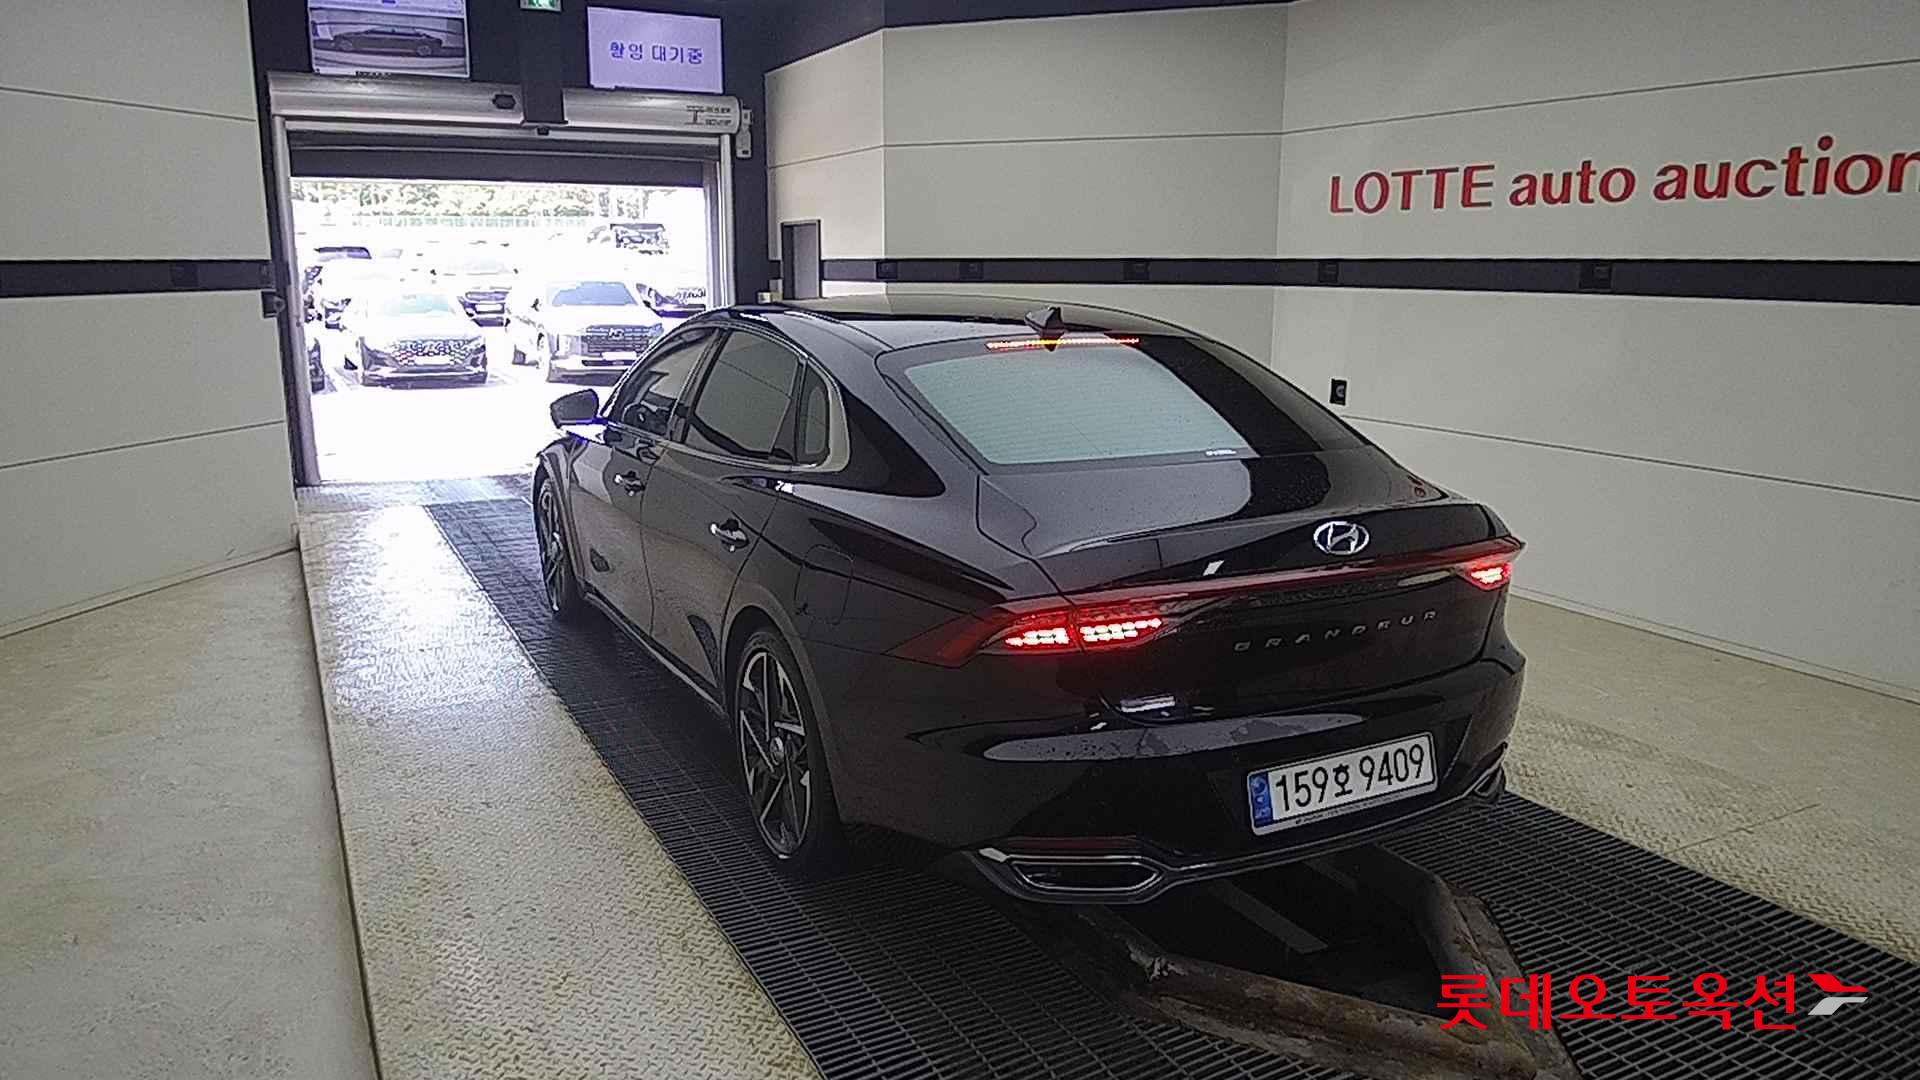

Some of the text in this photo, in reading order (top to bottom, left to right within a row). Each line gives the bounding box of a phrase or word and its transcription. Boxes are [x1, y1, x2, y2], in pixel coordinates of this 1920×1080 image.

[651, 45, 703, 65] 대기중
[1330, 135, 1920, 214] LOTTE auto auction
[1233, 610, 1437, 652] GRANDEUR
[1275, 743, 1425, 812] 159호 9409
